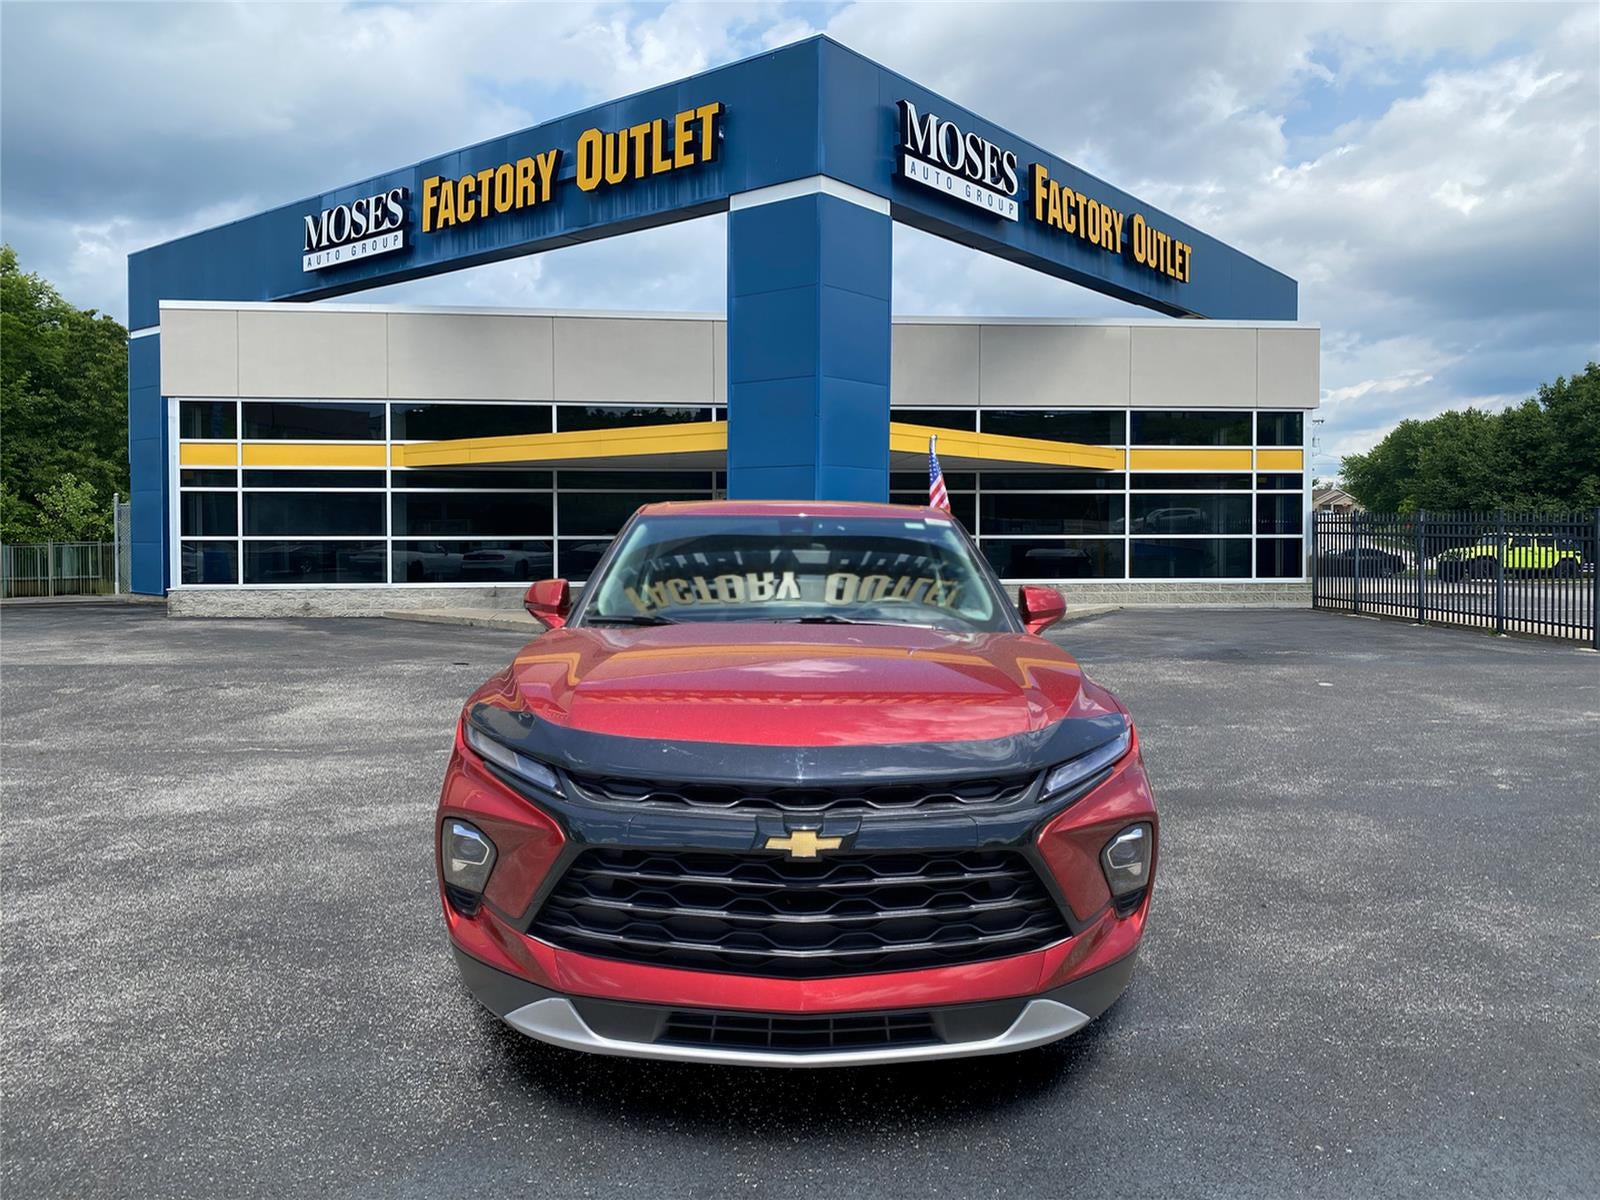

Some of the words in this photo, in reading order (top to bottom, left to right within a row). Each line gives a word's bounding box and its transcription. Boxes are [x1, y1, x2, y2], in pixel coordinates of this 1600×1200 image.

[421, 148, 559, 233] FACTORY
[576, 101, 721, 192] OUTLET
[904, 100, 1018, 195] MOSES
[303, 187, 404, 251] MOSES
[909, 160, 953, 190] AUTO
[964, 184, 1015, 215] GROUP
[1034, 163, 1124, 253] FACTORY
[1131, 212, 1192, 284] OUTLET
[306, 249, 341, 269] AUTO
[350, 234, 400, 254] GROUP
